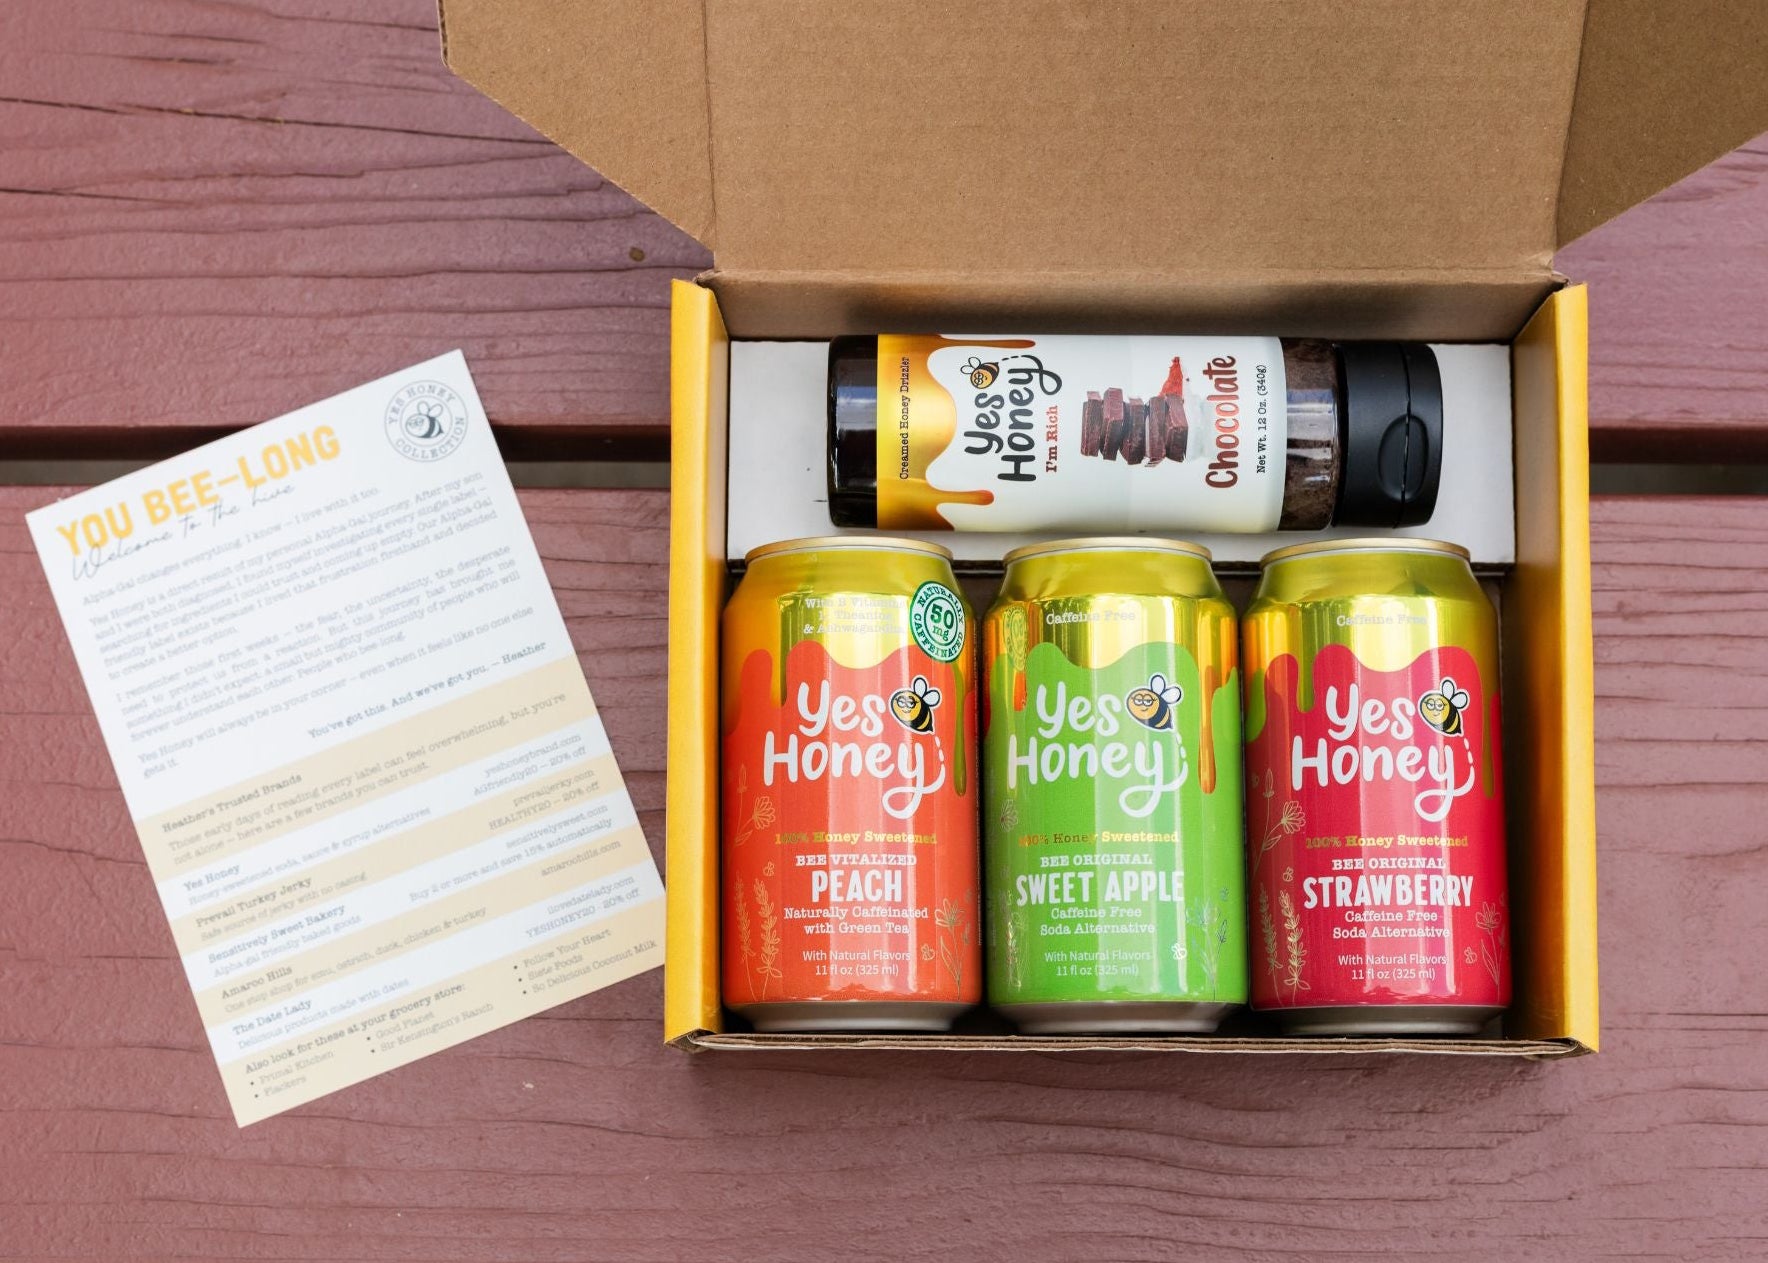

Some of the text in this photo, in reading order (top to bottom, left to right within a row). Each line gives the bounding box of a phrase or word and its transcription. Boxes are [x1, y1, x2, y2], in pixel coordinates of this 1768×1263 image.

[388, 384, 456, 425] YES HONEY
[900, 357, 910, 480] Creamed Honey Drizzler
[997, 354, 1062, 482] Honey
[1203, 355, 1240, 489] Chocolate
[1256, 364, 1268, 474] Net Wt. 12 Oz. (340g)
[395, 416, 464, 459] COLLECTION
[963, 392, 1005, 455] Yes
[1045, 405, 1058, 473] I'm Rich
[56, 502, 133, 556] YOU
[71, 483, 295, 581] Welcome to the hive
[917, 585, 964, 623] NATURALLY
[930, 604, 954, 630] 50
[914, 613, 964, 659] CAFFEINATED
[932, 624, 949, 642] mg
[307, 720, 344, 738] You've
[345, 712, 363, 724] got
[391, 691, 414, 707] And
[414, 681, 445, 697] we've
[446, 673, 465, 686] got
[501, 642, 546, 664] Heather
[797, 679, 887, 738] Yes
[1036, 681, 1122, 739] Yes
[1325, 683, 1416, 741] Yes
[549, 752, 572, 767] 20%
[572, 745, 586, 758] off
[562, 787, 585, 802] 20%
[585, 780, 600, 793] off
[763, 731, 946, 820] Honey
[1008, 734, 1189, 818] Honey
[1291, 735, 1475, 822] Honey
[162, 774, 302, 833] Heather's Trusted Brands
[813, 833, 861, 845] Honey
[864, 831, 937, 844] Sweetened
[1053, 833, 1098, 845] Honey
[1101, 831, 1179, 843] Sweetened
[1345, 835, 1393, 848] Honey
[1397, 834, 1469, 847] Sweetened
[183, 864, 240, 891] Yes Honey
[409, 888, 430, 903] Buy
[439, 880, 452, 890] or
[452, 870, 479, 885] more
[480, 860, 500, 875] and
[500, 853, 523, 868] save
[796, 854, 918, 867] BEE VITALIZED
[1040, 853, 1153, 868] BEE ORIGINAL
[1332, 857, 1446, 871] BEE ORIGINAL
[195, 877, 312, 928] Prevail Turkey Jerky
[602, 894, 625, 909] 20%
[625, 887, 640, 900] off
[811, 869, 902, 903] PEACH
[1016, 870, 1185, 907] SWEET APPLE
[1302, 874, 1474, 909] STRAWBERRY
[784, 906, 929, 920] Naturally Caffeinated
[804, 922, 911, 935] with Green Tea
[1040, 923, 1155, 936] Soda Alternative
[1051, 906, 1142, 920] Caffeine Free
[1344, 910, 1438, 924] Caffeine Free
[208, 905, 345, 964] Sensitively Sweet Bakery
[522, 929, 612, 968] Follow Your Heart
[1332, 926, 1451, 939] Soda Alternative
[531, 940, 658, 994] So Delicious Coconut Milk
[802, 950, 911, 961] With Natural Flavors
[815, 963, 899, 977] 11 fl oz (325 ml)
[1044, 950, 1150, 962] With Natural Flavors
[1055, 964, 1139, 977] 11 fl oz (325 ml)
[1338, 954, 1447, 966] With Natural Flavors
[265, 966, 293, 982] Hills
[1351, 968, 1436, 981] 11 fl oz (325 ml)
[232, 1000, 311, 1035] The Date Lady
[245, 981, 468, 1074] Also look for these at your grocery store:
